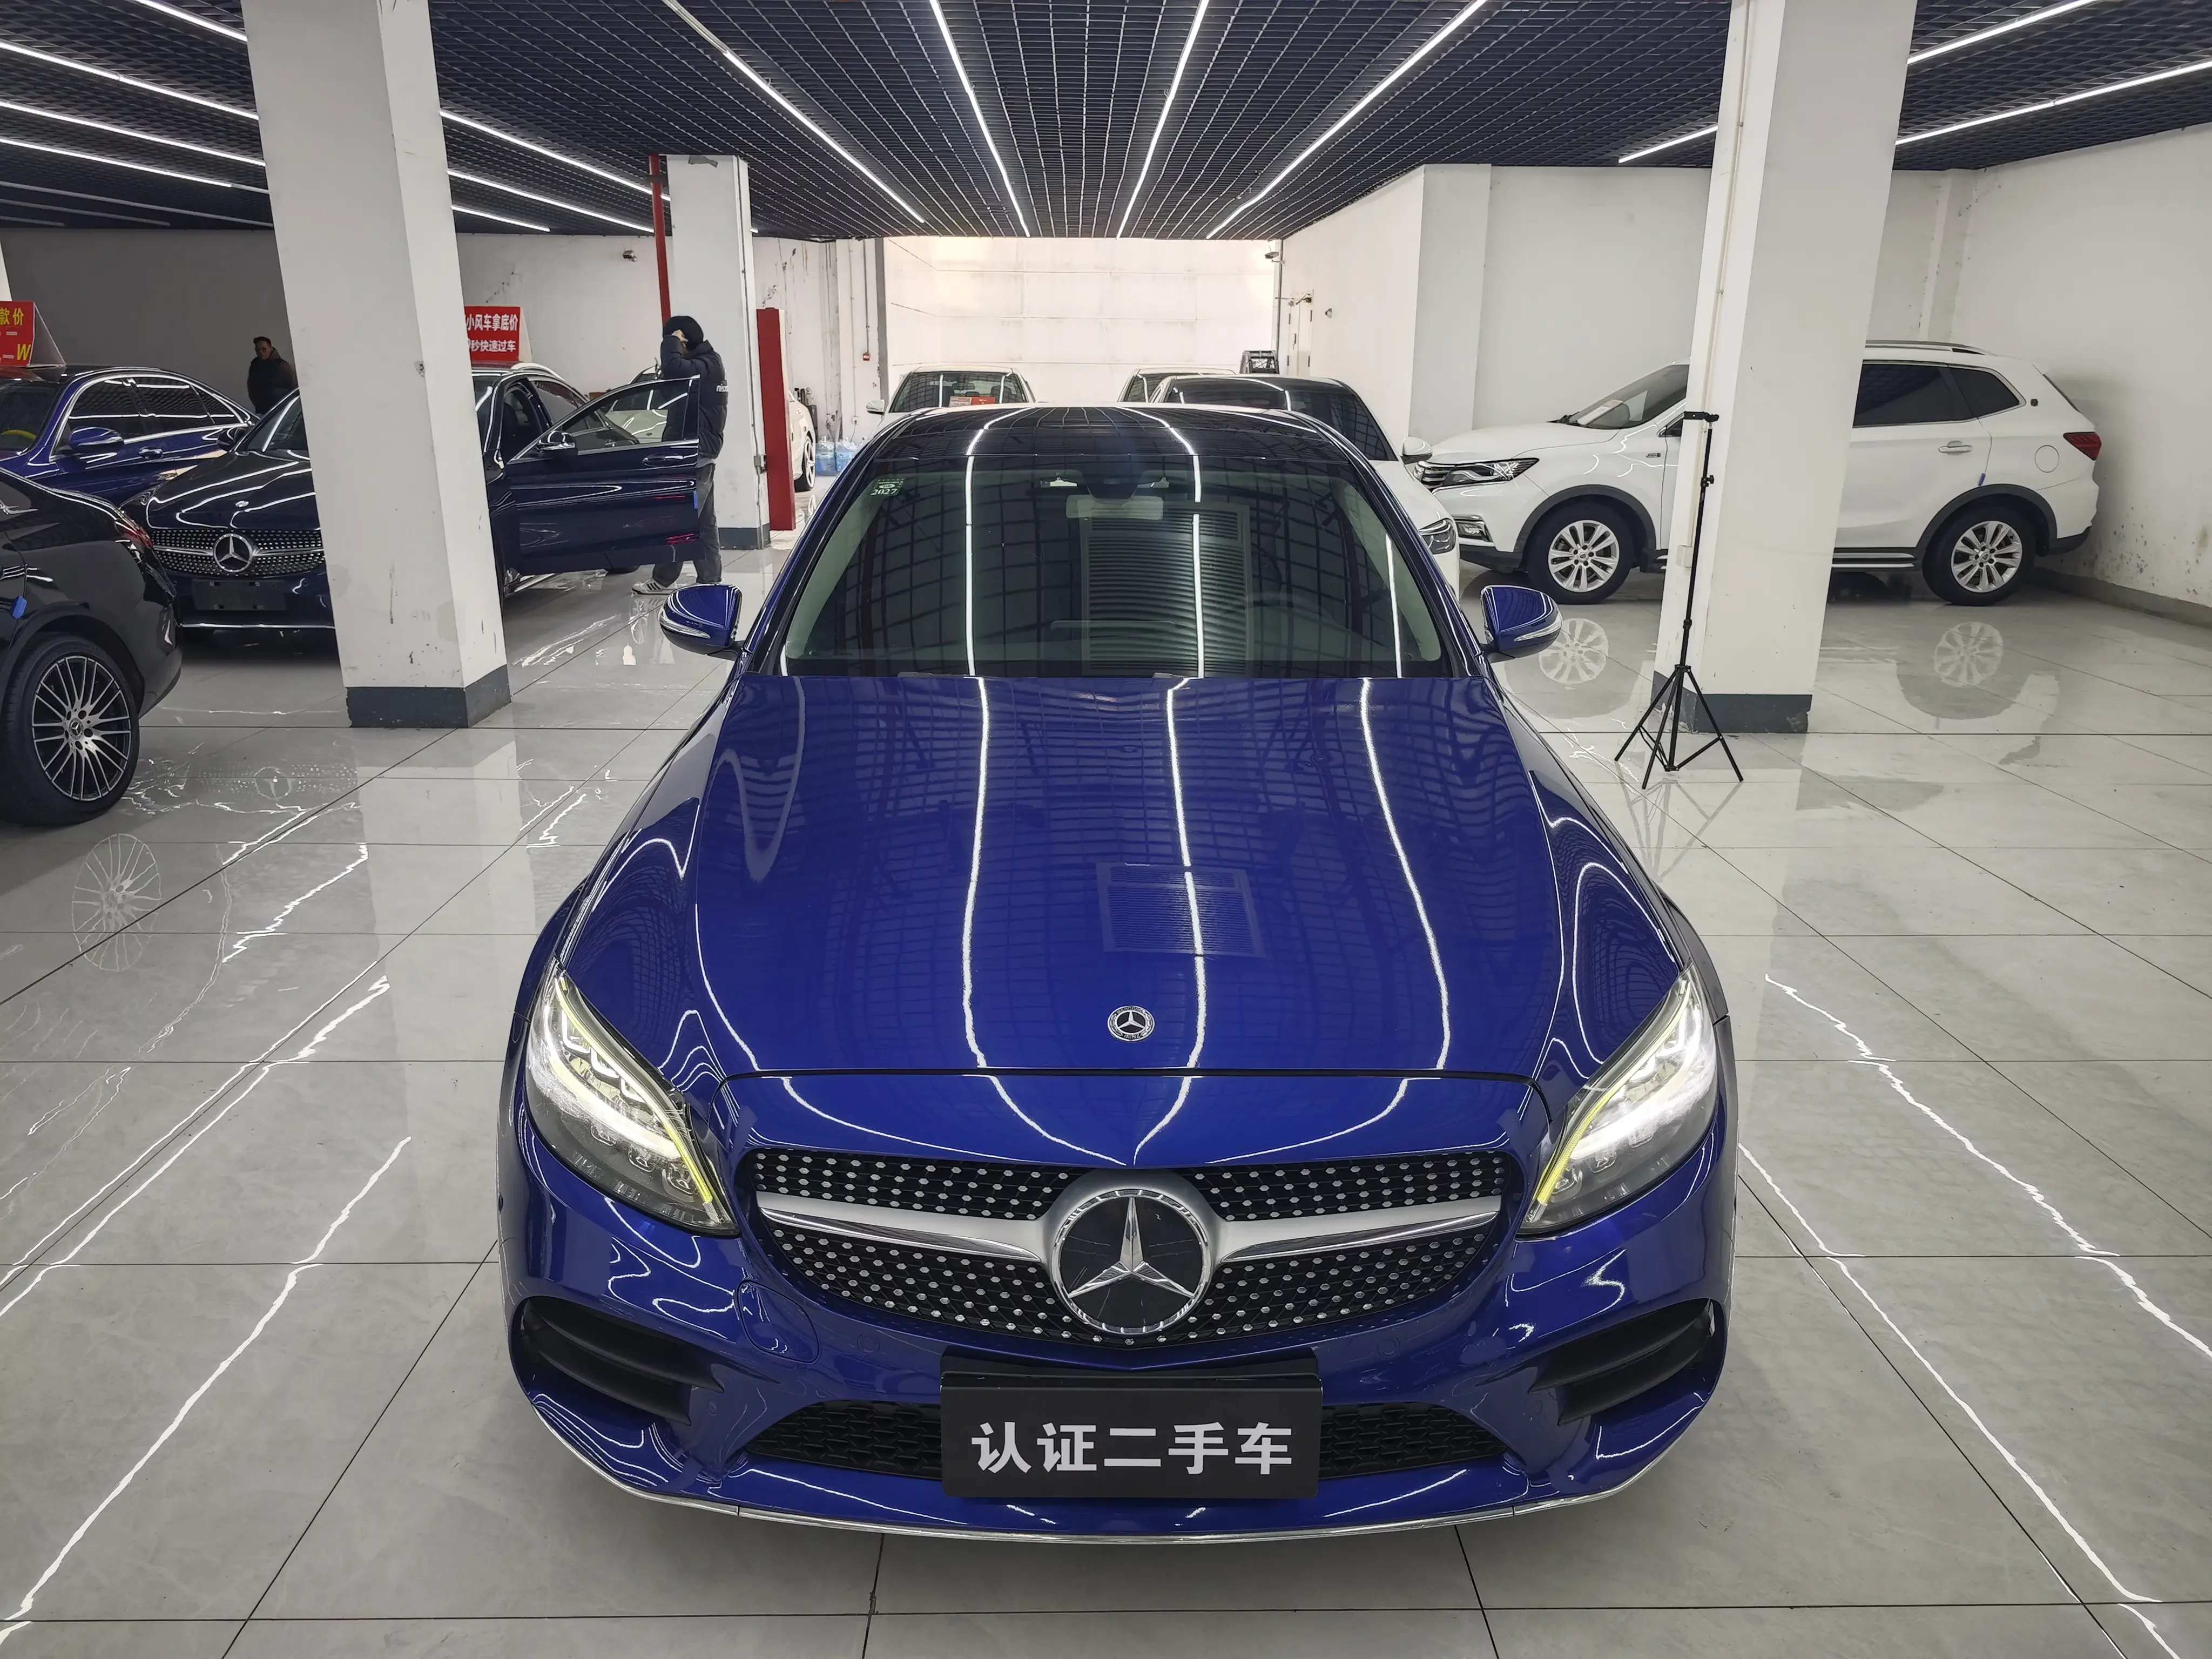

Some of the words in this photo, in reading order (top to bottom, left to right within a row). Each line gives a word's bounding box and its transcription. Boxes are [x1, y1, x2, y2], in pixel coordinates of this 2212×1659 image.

[0, 307, 24, 325] 款价
[465, 313, 518, 331] 小风车拿底价
[17, 343, 31, 361] W
[972, 1421, 1292, 1475] 认证二手车
